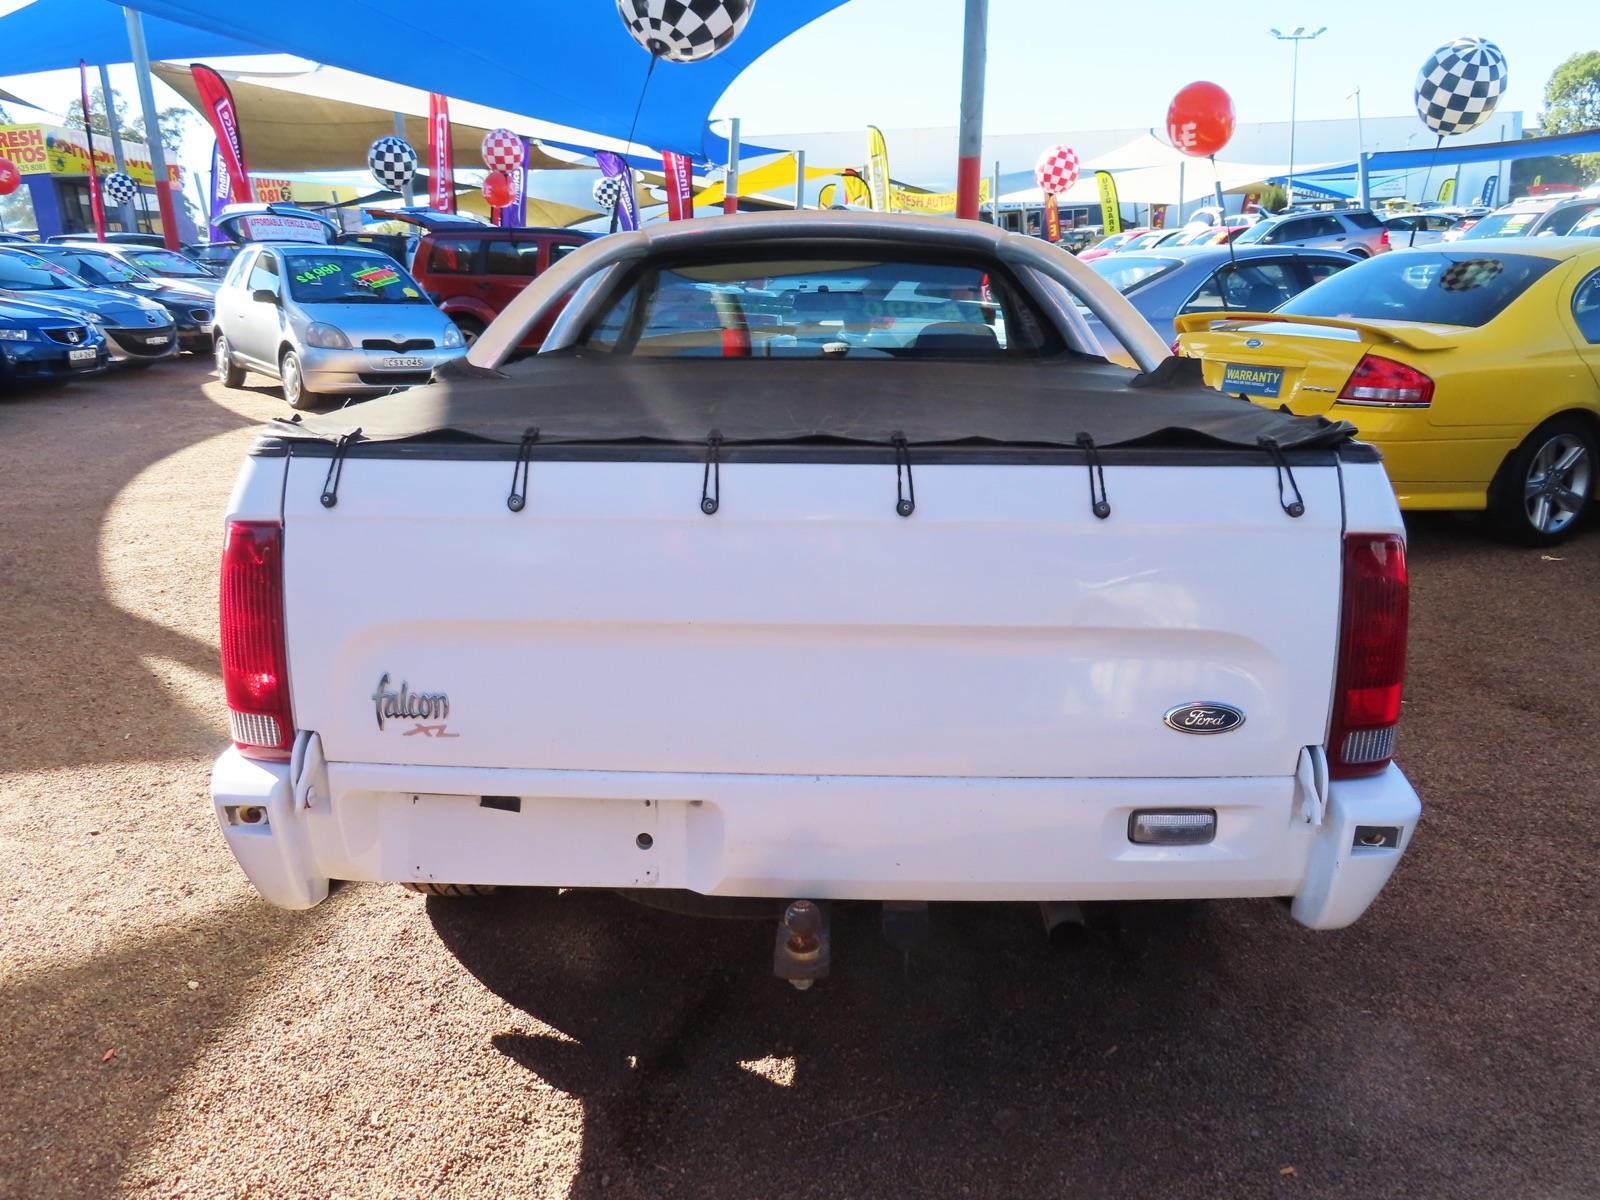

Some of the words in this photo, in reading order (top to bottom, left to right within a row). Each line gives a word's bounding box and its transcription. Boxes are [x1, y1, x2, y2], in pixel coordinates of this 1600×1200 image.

[296, 263, 342, 283] $4,990
[1226, 368, 1280, 384] WARRANTY
[1184, 709, 1226, 726] Ford
